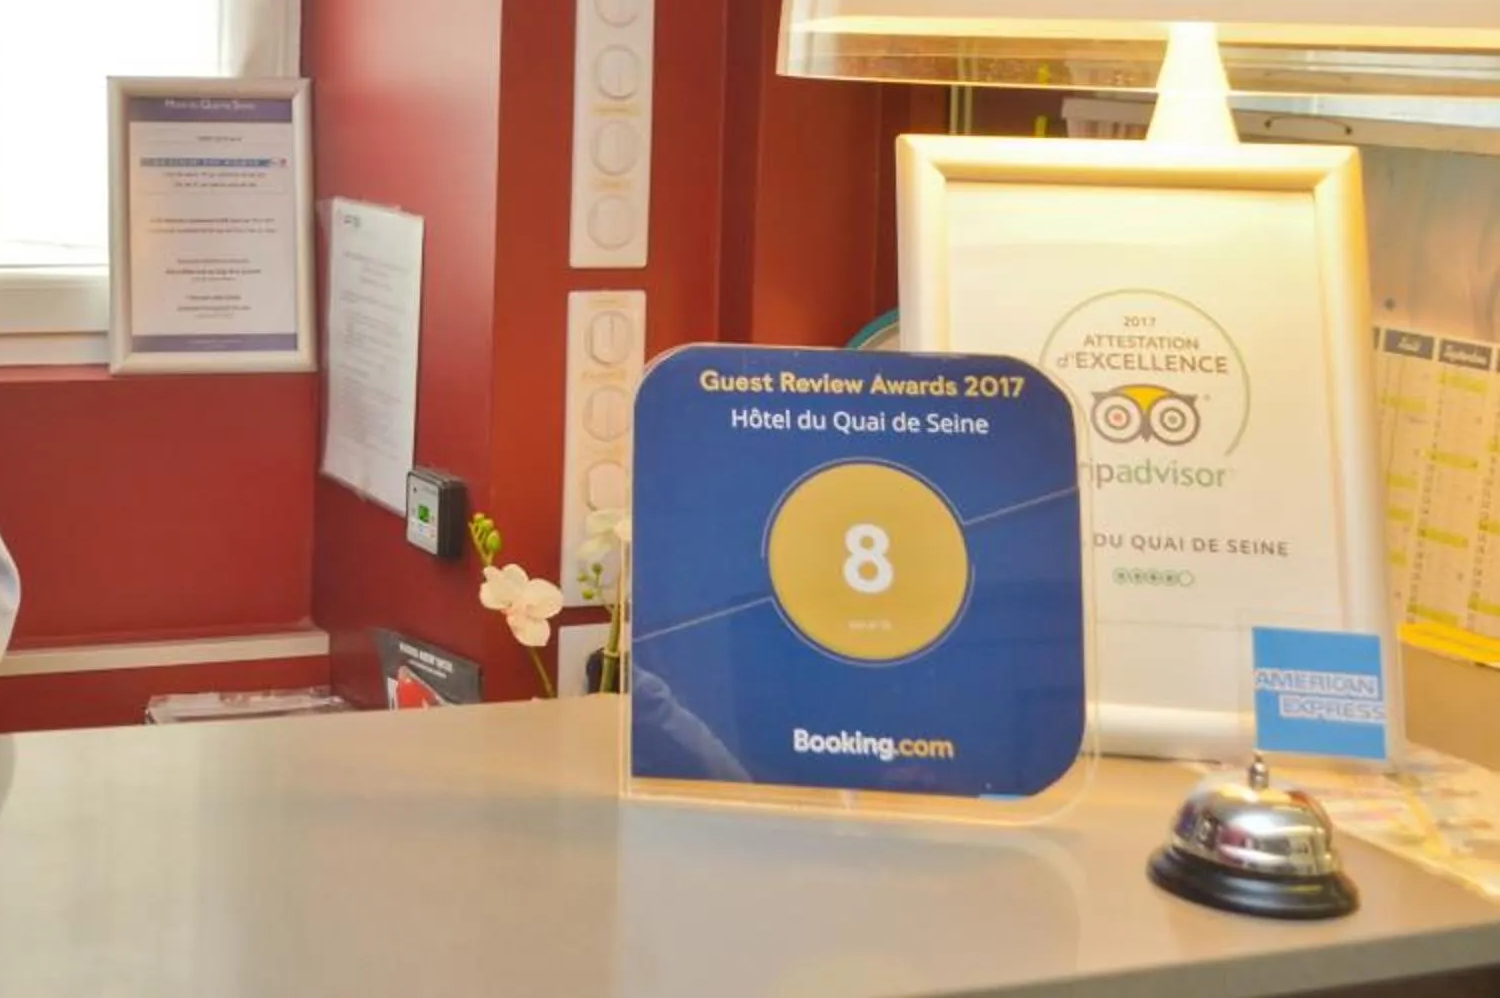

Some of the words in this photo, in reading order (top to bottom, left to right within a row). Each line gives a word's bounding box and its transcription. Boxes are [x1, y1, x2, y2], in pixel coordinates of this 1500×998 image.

[1123, 315, 1156, 327] 2017
[1083, 334, 1199, 350] ATTESTATION
[1056, 352, 1229, 375] d'EXCELLENCE
[699, 370, 774, 392] Guest
[780, 371, 864, 394] Review
[870, 373, 958, 397] Awards
[964, 376, 1025, 398] 2017
[731, 407, 790, 429] Hôtel
[798, 409, 826, 430] du
[832, 410, 885, 434] Quai
[892, 412, 921, 433] de
[927, 413, 990, 434] Seine
[1092, 533, 1123, 549] DU
[1130, 534, 1184, 553] QUAI
[1192, 537, 1219, 553] DE
[1226, 538, 1289, 557] SEINE
[843, 523, 894, 594] 8
[1255, 671, 1375, 695] AMERICAN
[1283, 696, 1387, 720] EXPRESS
[793, 728, 954, 761] Booking.com
